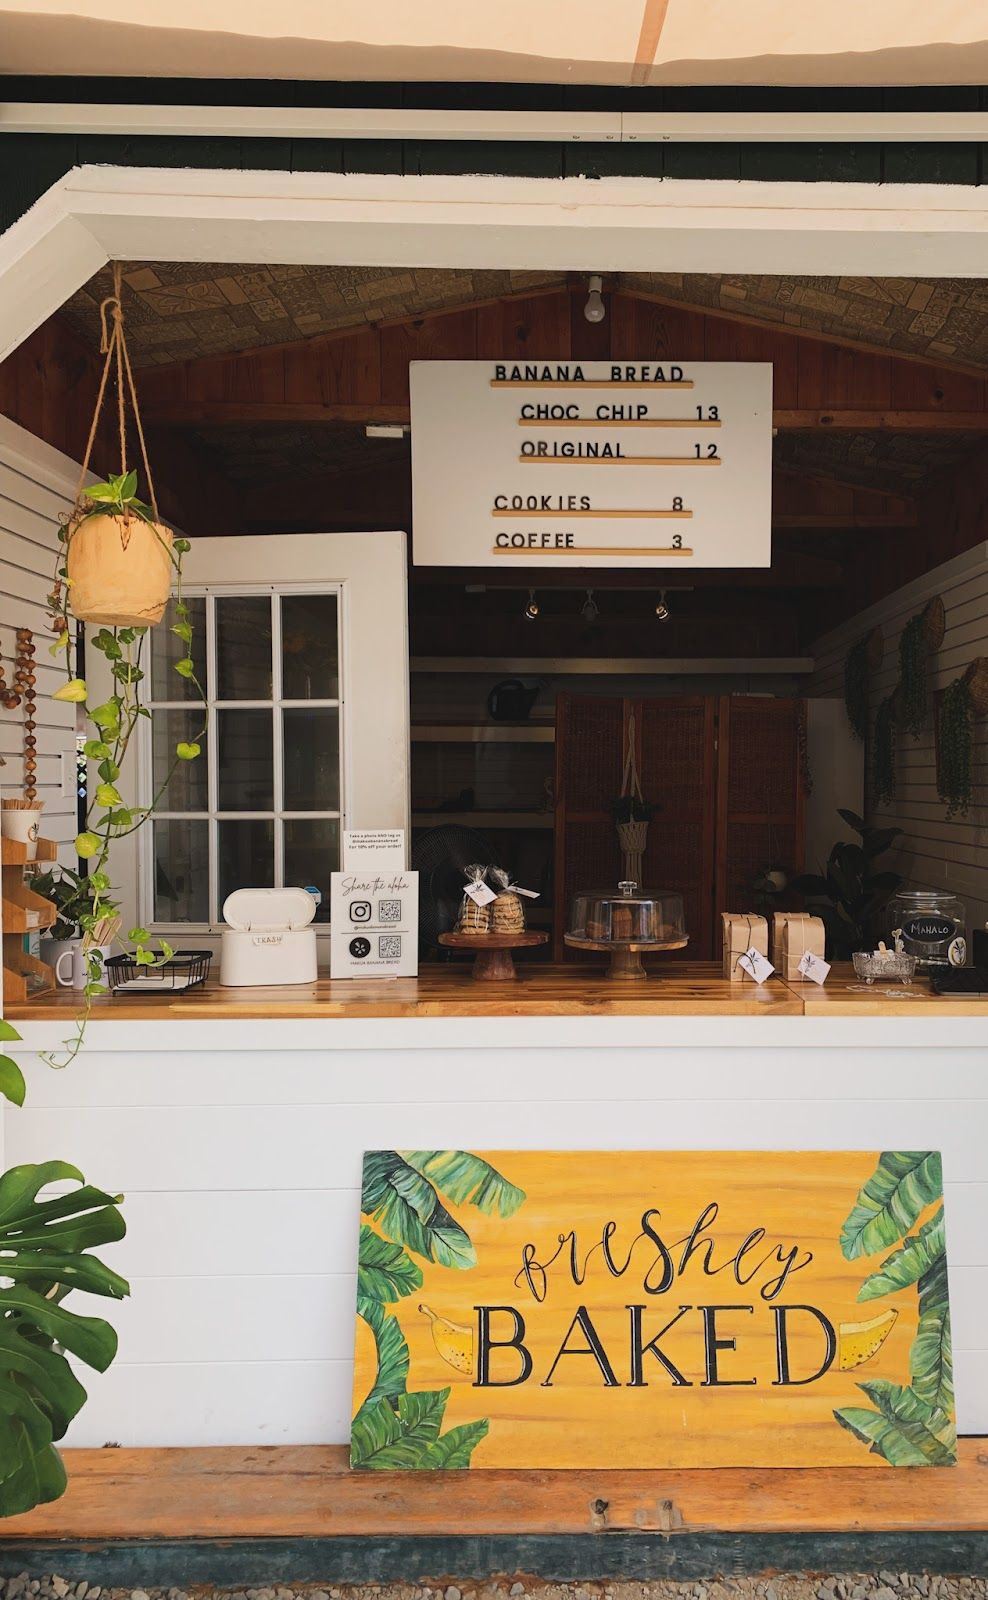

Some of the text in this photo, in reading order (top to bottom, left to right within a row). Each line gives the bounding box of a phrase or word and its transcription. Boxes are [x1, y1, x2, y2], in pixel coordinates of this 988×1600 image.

[495, 365, 684, 381] BANANA BREAD
[520, 404, 719, 420] CHOC CHIP 13
[520, 441, 718, 458] ORIGINAL 12
[672, 497, 683, 511] 8
[495, 533, 682, 549] COFFEE 3
[341, 876, 409, 896] Share the aloha
[911, 922, 949, 934] MAHALO
[472, 1304, 837, 1387] BAKED
